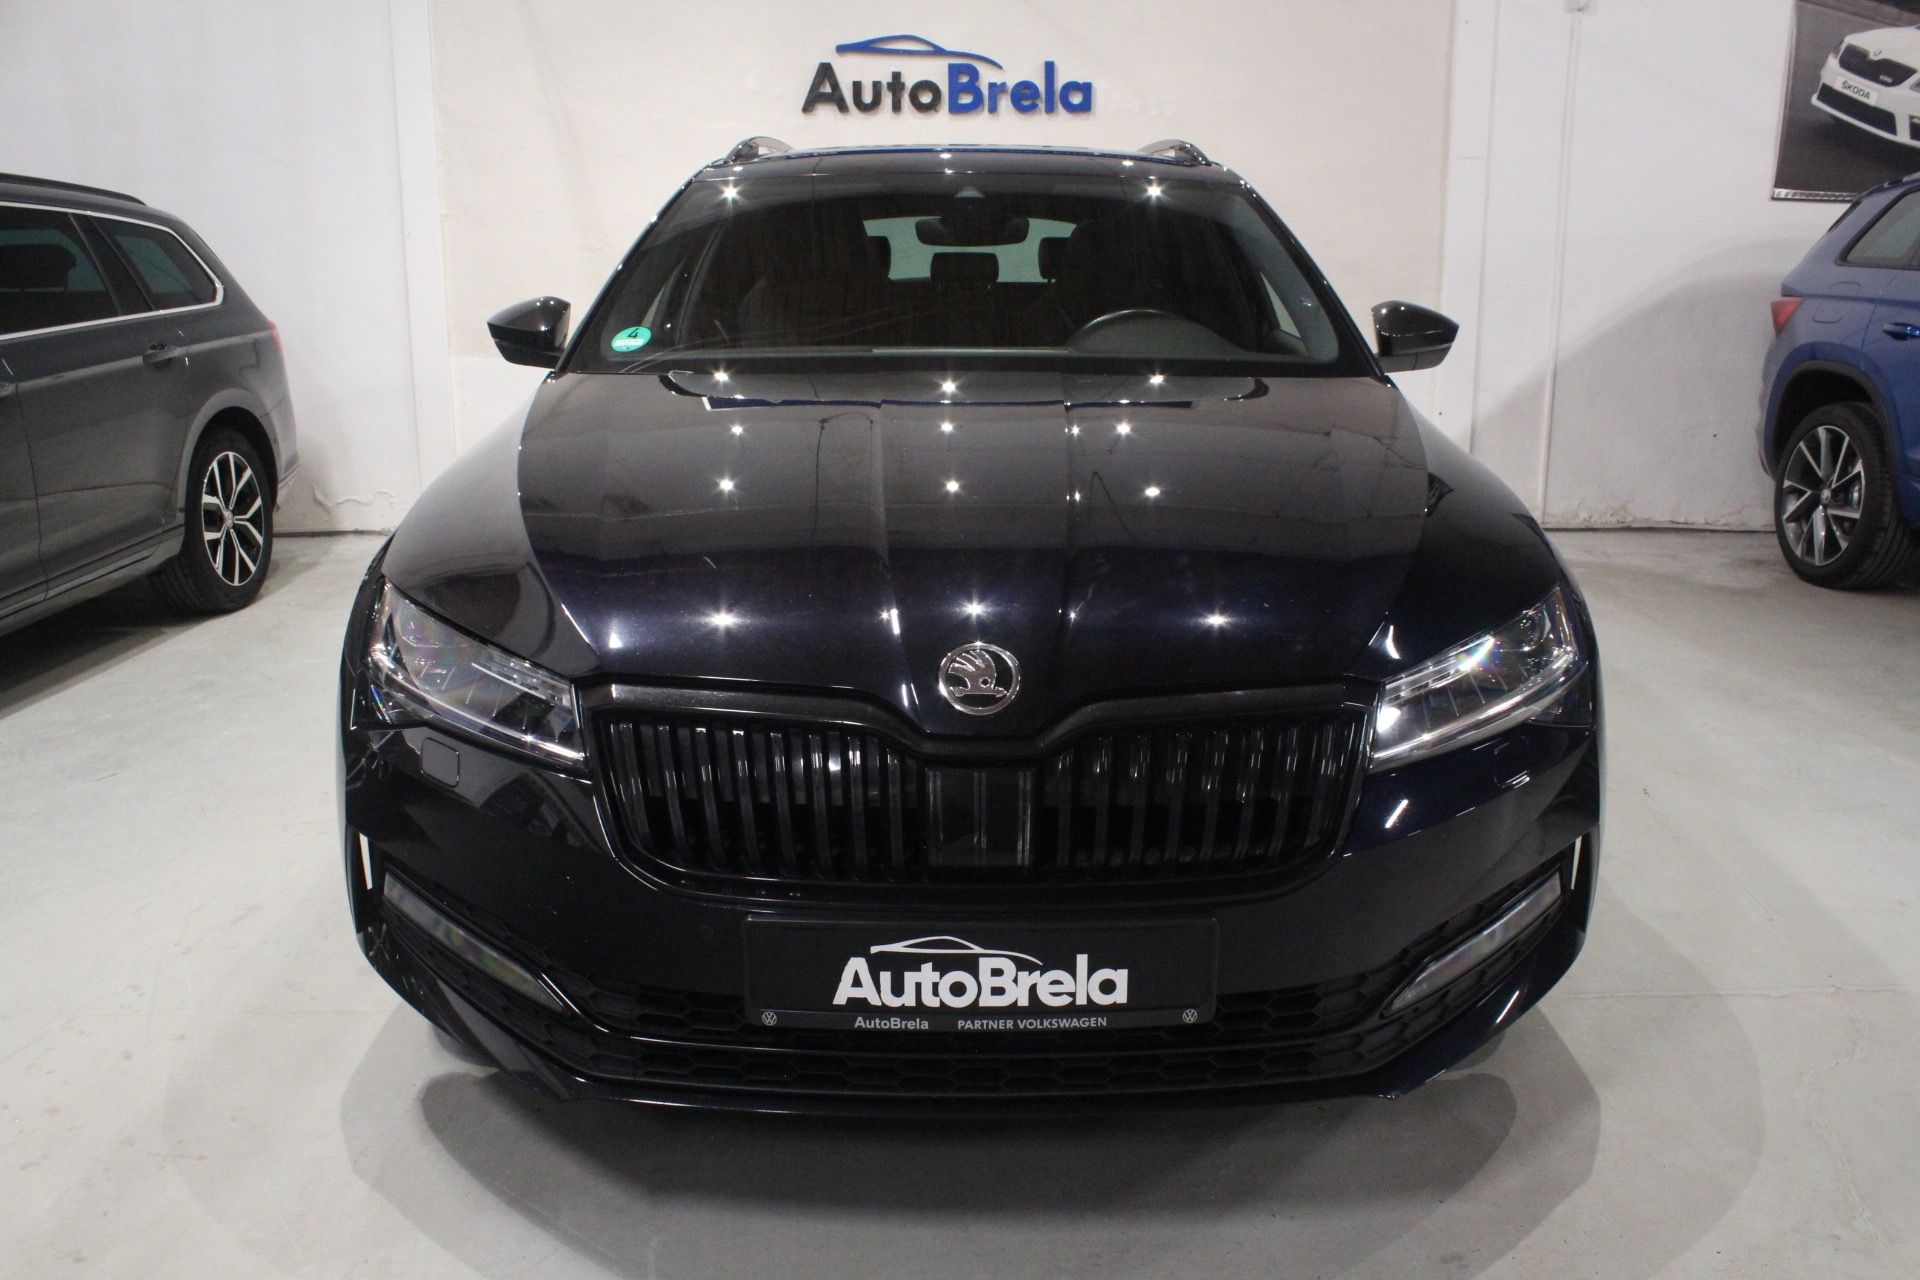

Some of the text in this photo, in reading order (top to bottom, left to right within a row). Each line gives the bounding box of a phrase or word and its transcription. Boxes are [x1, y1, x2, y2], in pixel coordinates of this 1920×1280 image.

[802, 61, 1092, 113] AutoBrela
[627, 327, 640, 339] 4
[832, 954, 1128, 1007] AutoBrela
[855, 1016, 1107, 1030] AutoBrela PARTNER VOLKSWAGEN
